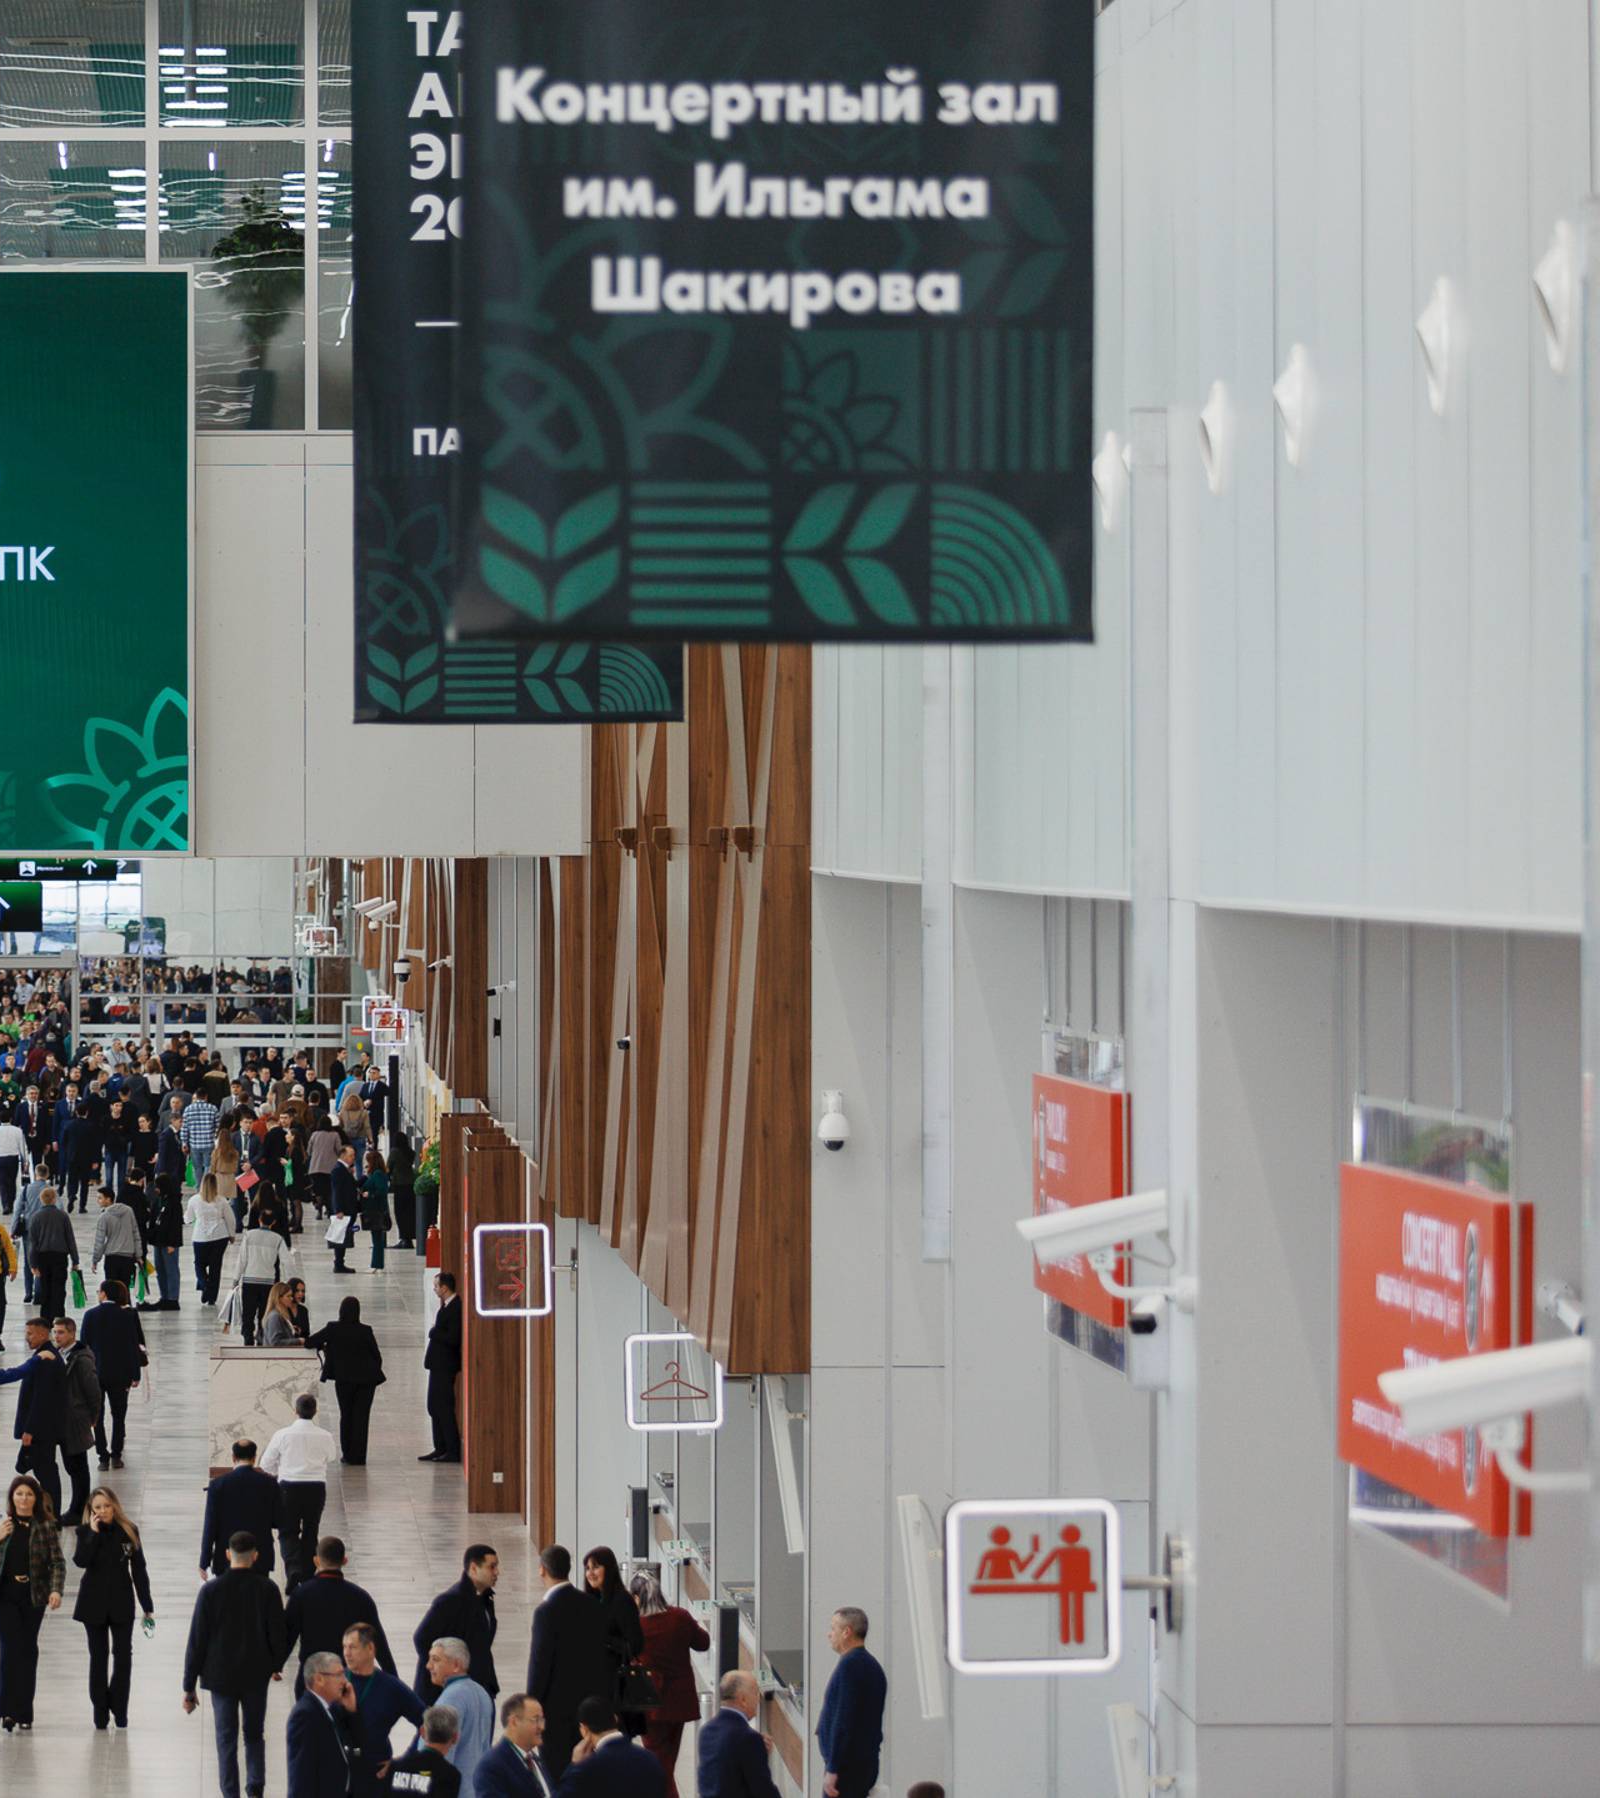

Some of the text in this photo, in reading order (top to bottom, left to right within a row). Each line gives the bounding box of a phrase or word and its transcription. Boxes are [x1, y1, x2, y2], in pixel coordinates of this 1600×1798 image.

[496, 66, 1058, 139] Концертный зал
[563, 161, 990, 219] им. Ильгама
[591, 256, 961, 330] Шакирова
